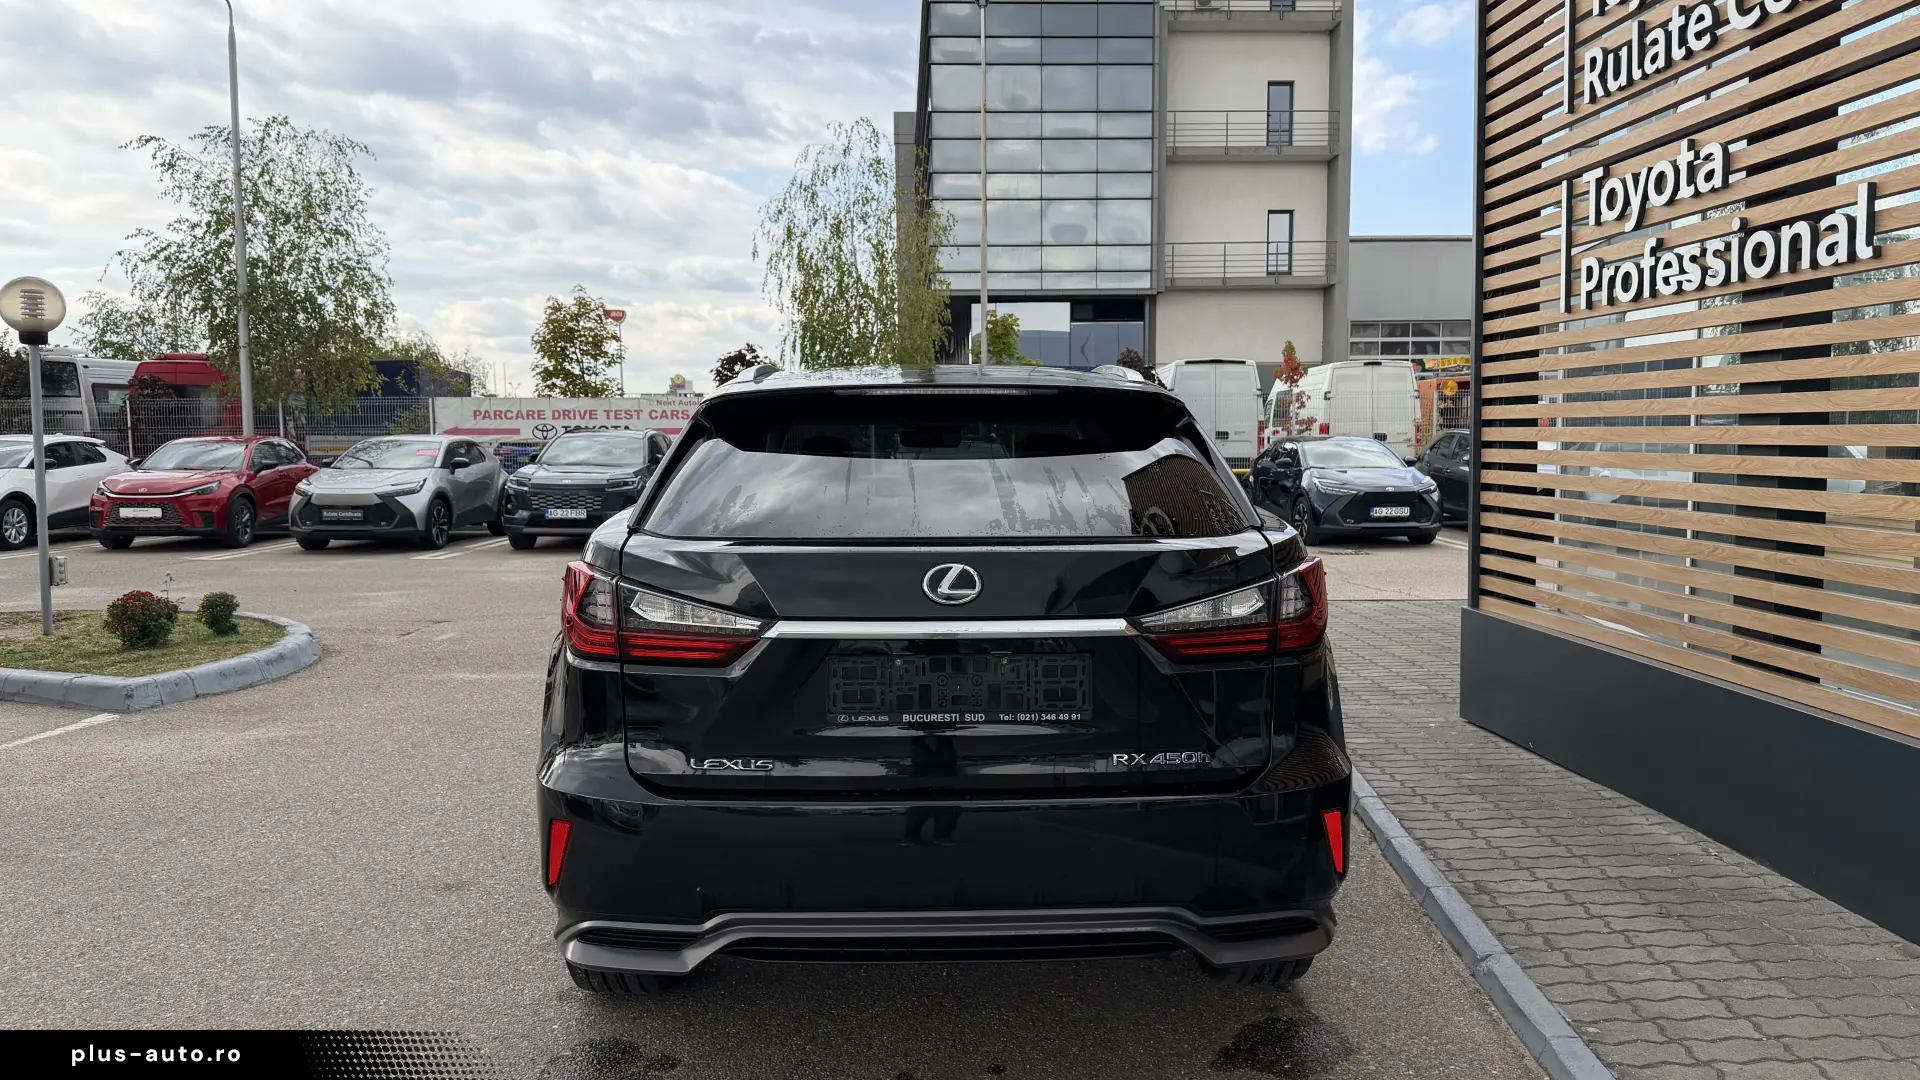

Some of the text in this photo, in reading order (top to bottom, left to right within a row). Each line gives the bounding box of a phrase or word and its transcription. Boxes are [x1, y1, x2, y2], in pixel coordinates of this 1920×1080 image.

[1583, 3, 1713, 104] Rulate
[1583, 139, 1726, 232] Toyota
[1581, 182, 1876, 310] Professional
[473, 409, 690, 420] PARCARE DRIVE TEST CARS
[560, 509, 570, 517] 22
[570, 509, 586, 517] FBR
[1385, 507, 1393, 515] 22
[1394, 507, 1409, 515] GSU
[902, 713, 960, 722] BUCURESTI
[964, 713, 985, 722] SUD
[999, 713, 1015, 721] Tel:
[1017, 713, 1039, 721] (021)
[1040, 713, 1056, 721] 346
[1058, 713, 1069, 721] 49
[1070, 713, 1081, 721] 91
[690, 758, 774, 771] LEXUS
